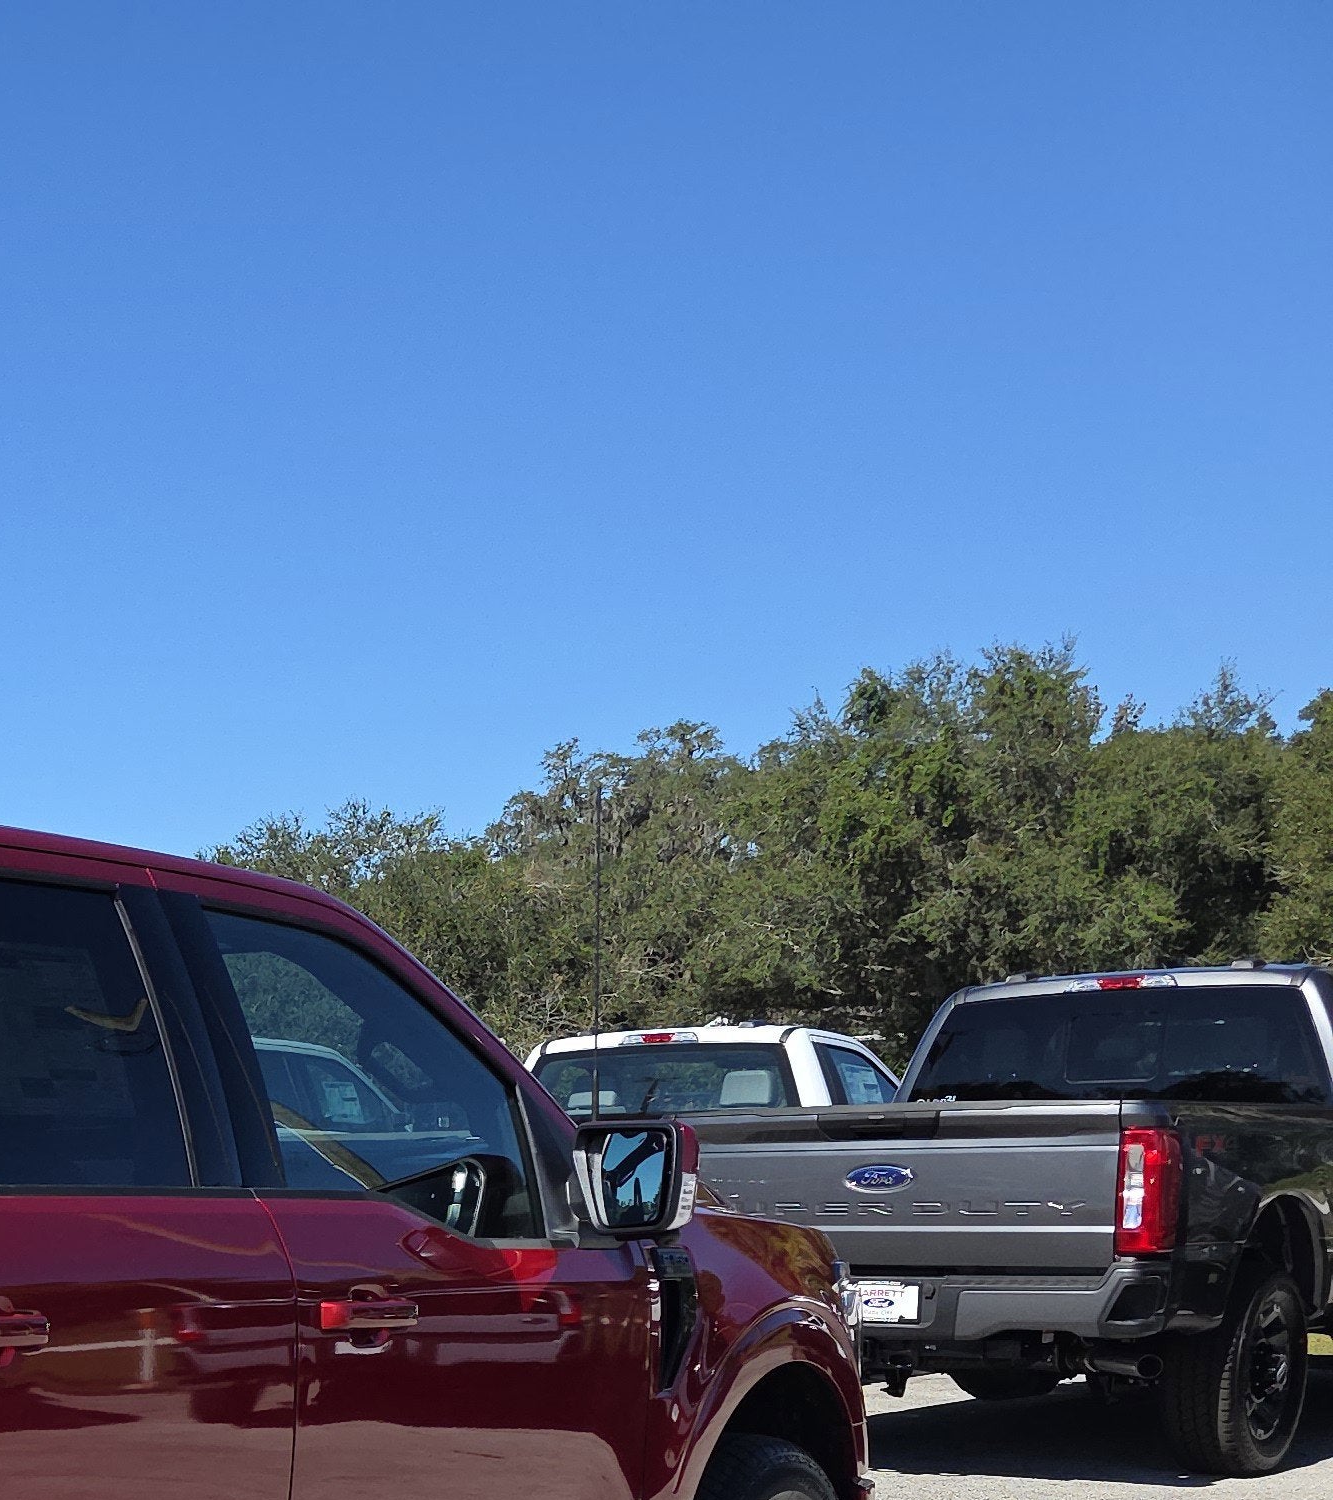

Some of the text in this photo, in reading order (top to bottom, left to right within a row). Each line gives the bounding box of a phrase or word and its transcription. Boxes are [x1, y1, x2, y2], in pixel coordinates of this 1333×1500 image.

[861, 1171, 896, 1185] Ford
[736, 1202, 1087, 1216] UPER DUTY
